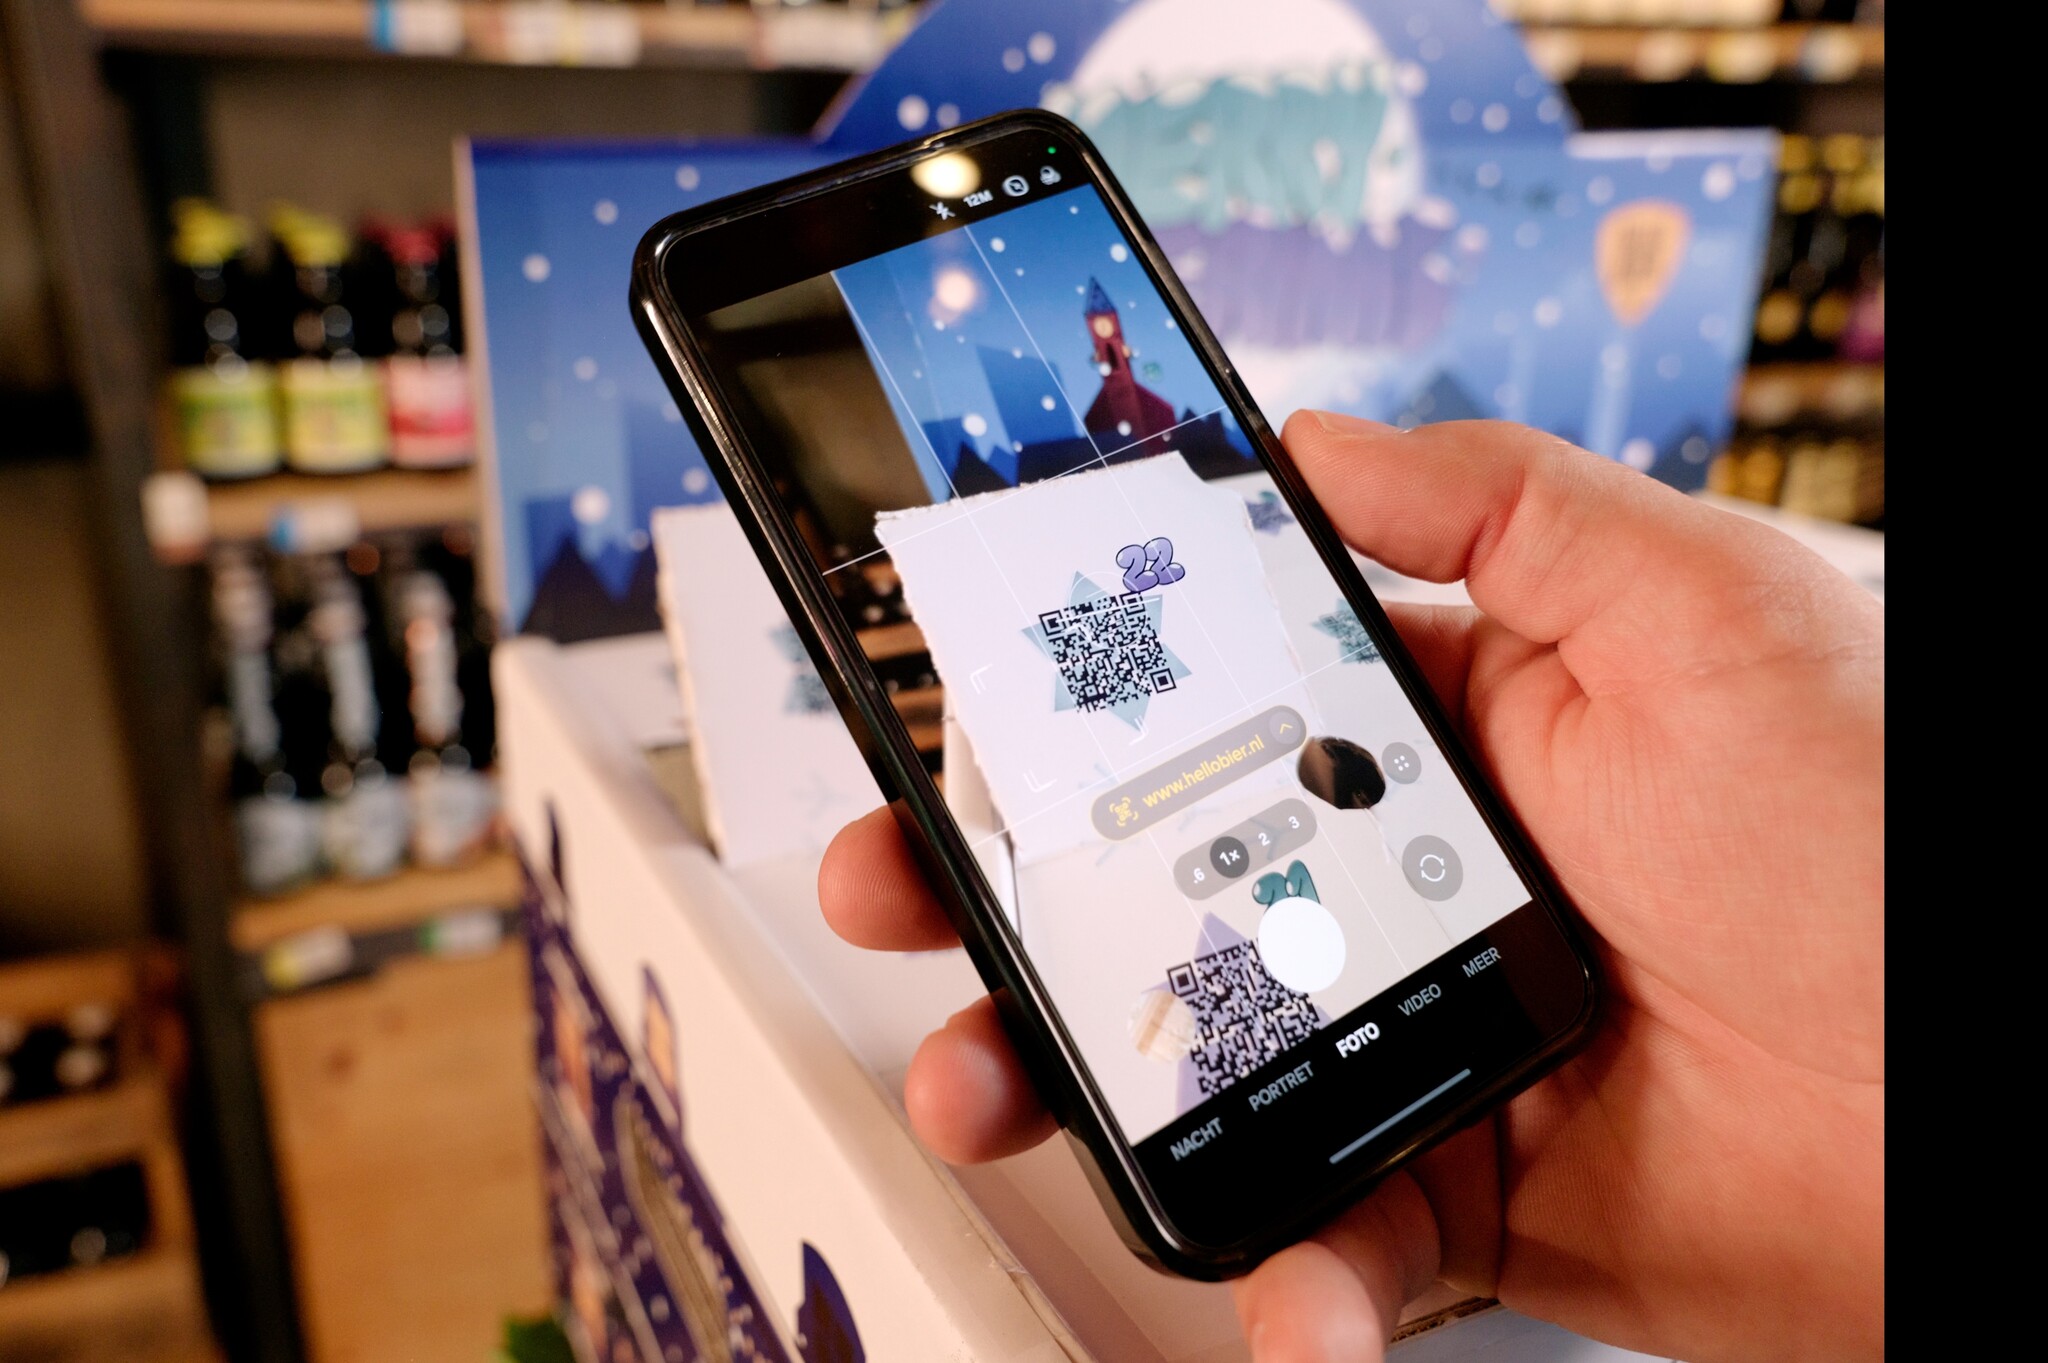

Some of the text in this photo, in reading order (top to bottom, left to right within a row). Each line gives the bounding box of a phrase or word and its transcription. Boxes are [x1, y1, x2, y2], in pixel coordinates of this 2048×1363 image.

[963, 189, 993, 208] 12M
[1115, 536, 1186, 593] 22
[1142, 734, 1265, 809] www.hellobier.nl
[1258, 832, 1271, 847] 2
[1288, 815, 1300, 829] 3
[1169, 946, 1502, 1162] NACHT PORTRET FOTO VIDEO MEER
